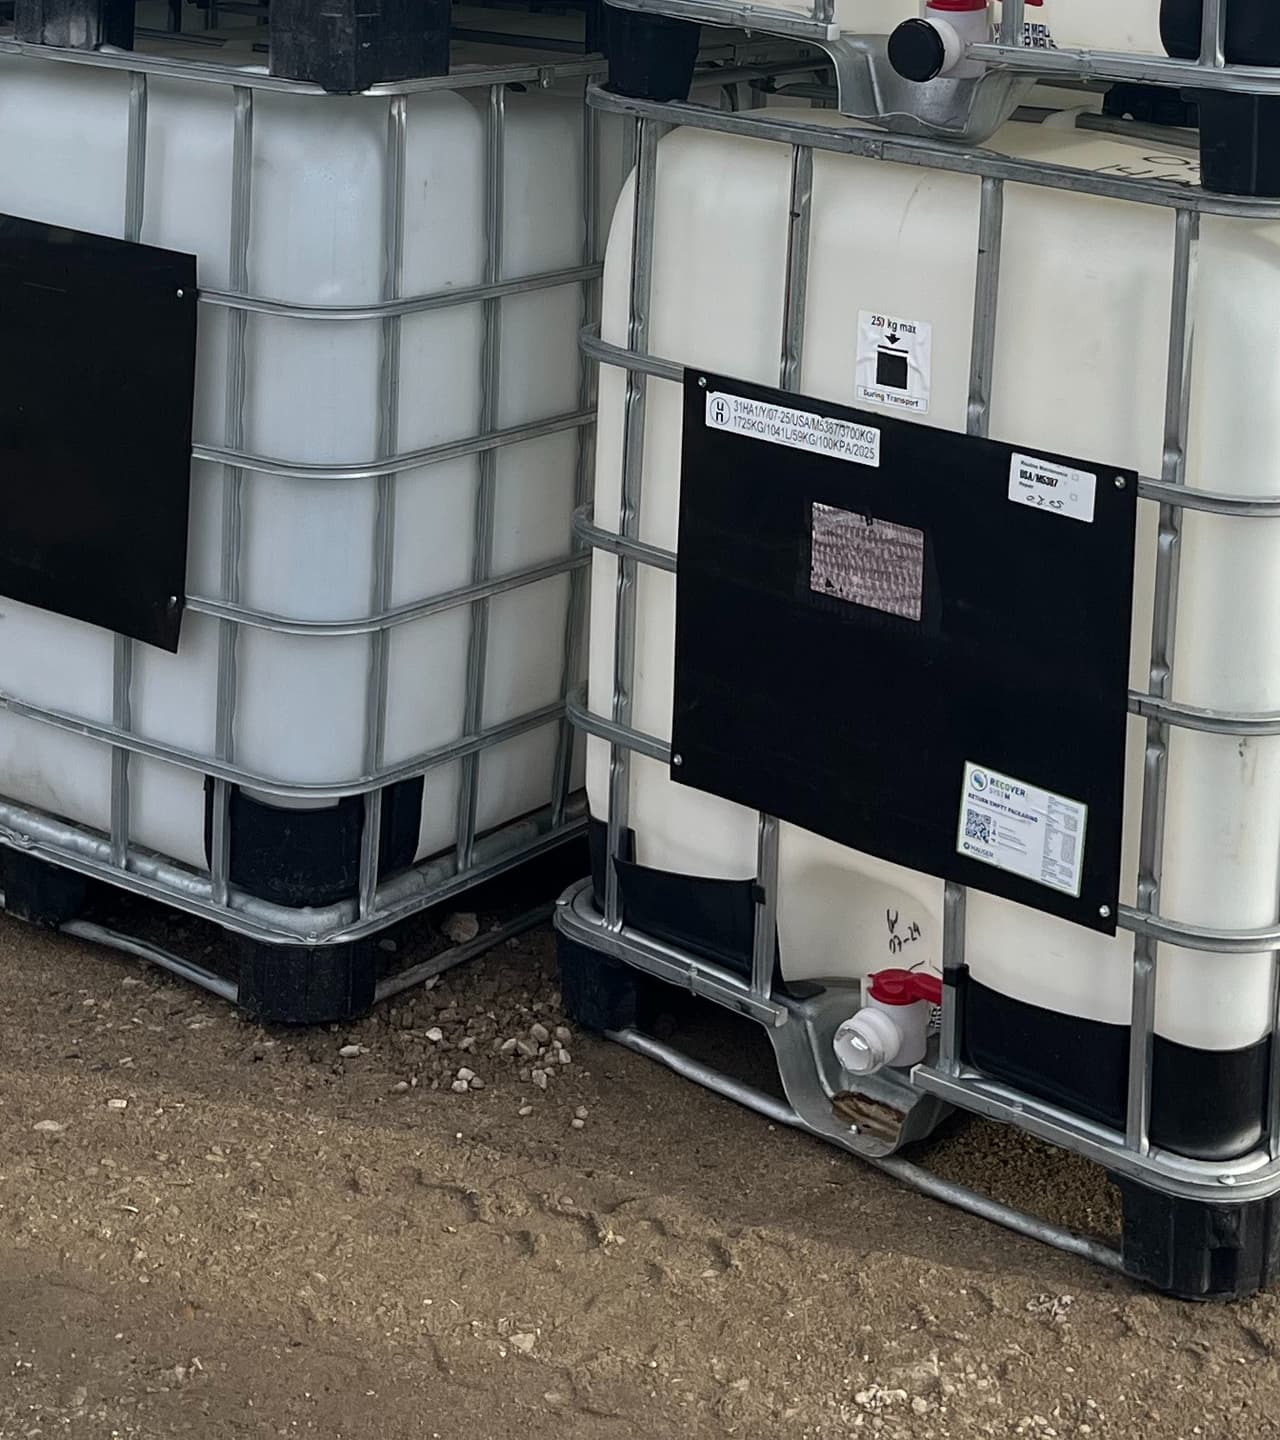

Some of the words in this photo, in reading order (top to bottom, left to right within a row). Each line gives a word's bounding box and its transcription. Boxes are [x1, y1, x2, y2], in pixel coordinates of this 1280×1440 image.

[888, 319, 898, 332] kg
[900, 323, 916, 334] max
[864, 390, 884, 401] During
[886, 394, 918, 407] Transport
[989, 786, 1011, 800] SYSTM
[990, 778, 1026, 798] RECOVER
[968, 792, 988, 804] RETURN
[1008, 808, 1038, 823] PACKAGING
